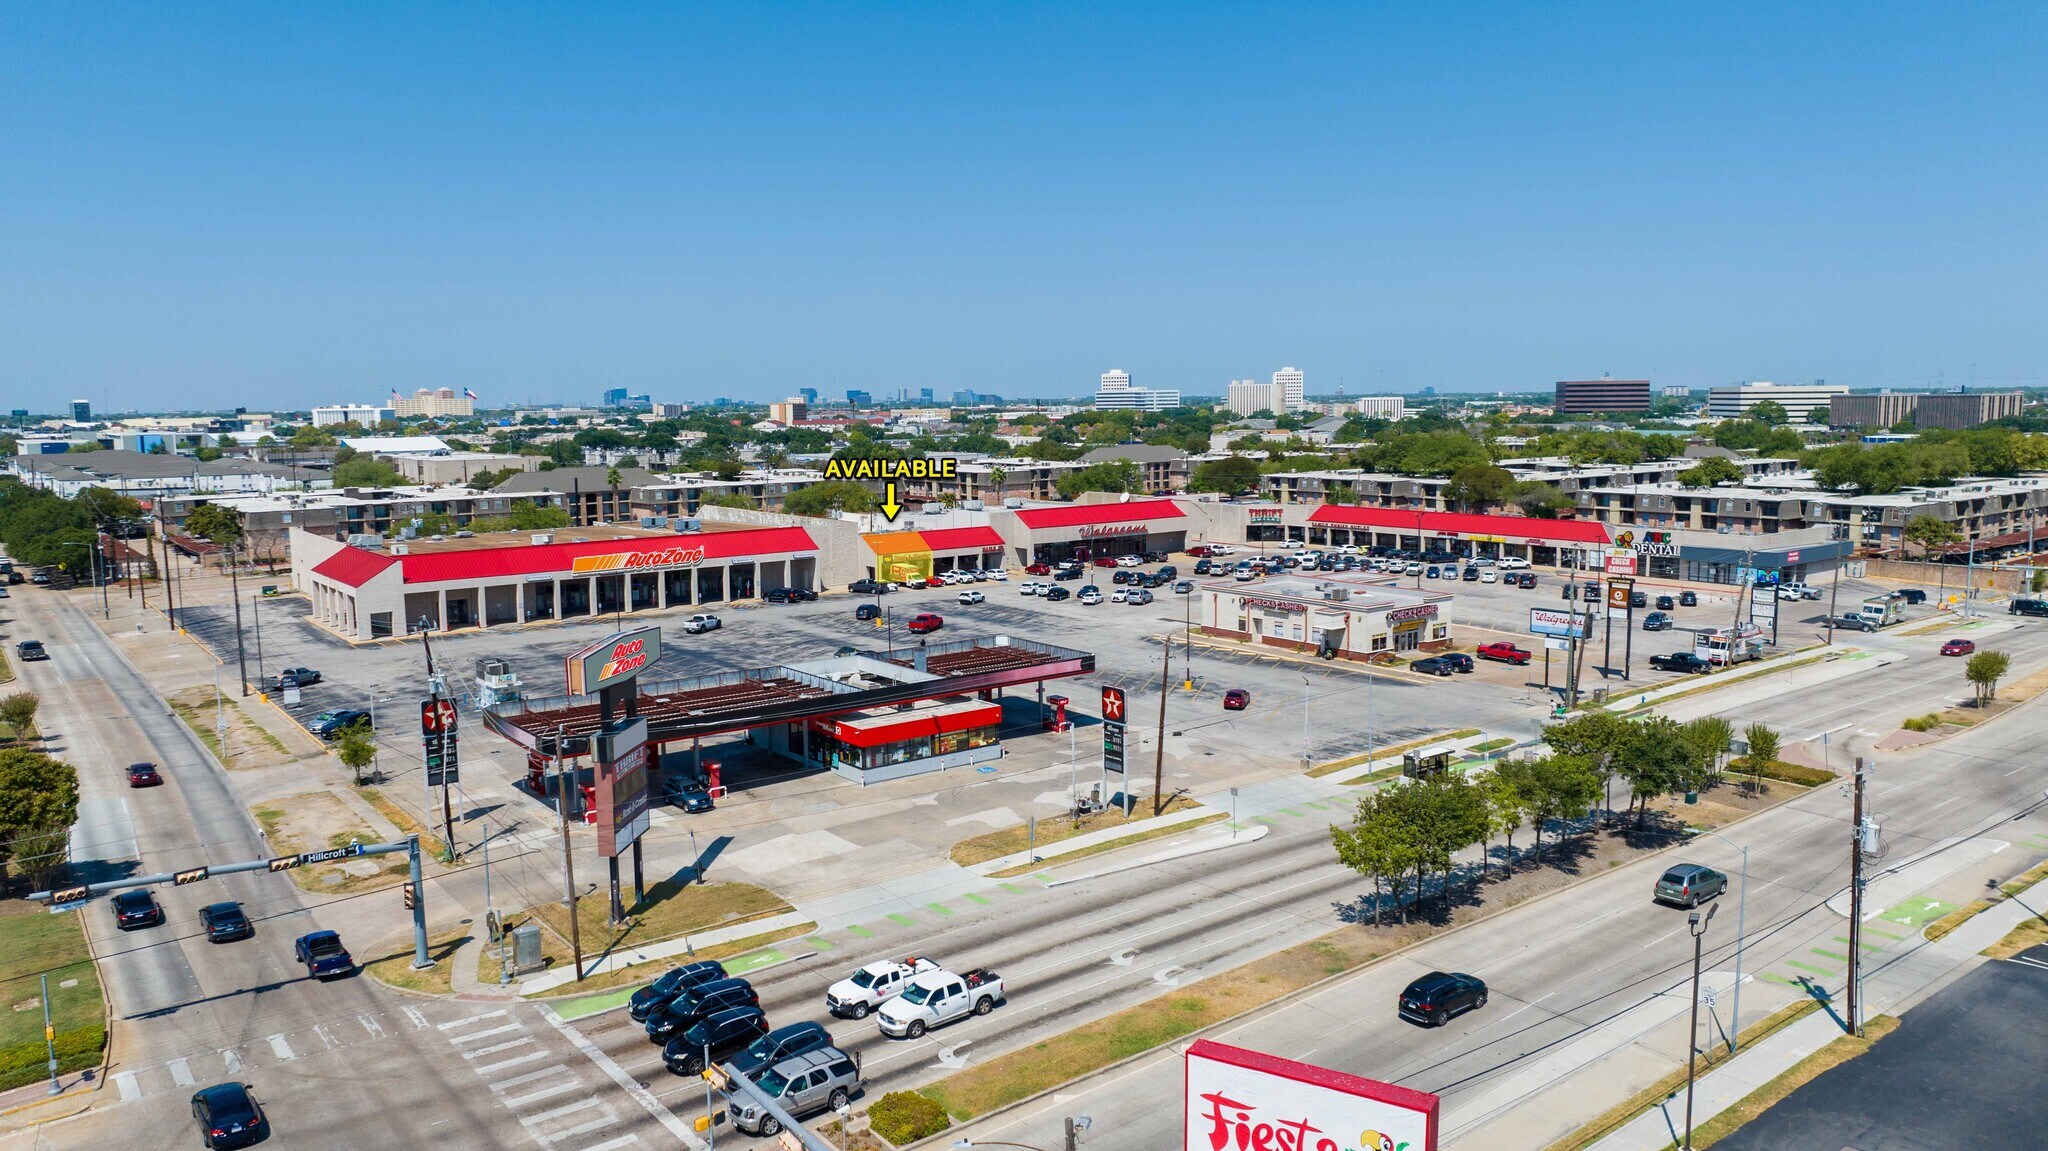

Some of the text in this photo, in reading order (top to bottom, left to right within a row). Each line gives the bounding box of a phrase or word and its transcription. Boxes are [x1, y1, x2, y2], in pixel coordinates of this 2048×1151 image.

[1249, 508, 1283, 518] THRIFT
[1079, 524, 1148, 538] Walgreens
[1642, 531, 1672, 544] ABC
[624, 548, 702, 568] AutoZone
[1611, 557, 1631, 566] CHECK
[1608, 565, 1634, 574] CASHING
[1250, 599, 1276, 608] CHECKS
[1276, 602, 1304, 612] CASHED
[1393, 605, 1439, 620] CHECKS CASHED
[611, 639, 643, 661] Auto
[612, 653, 646, 677] Zone
[614, 746, 645, 772] THRIFT
[308, 848, 346, 863] Hillcroft
[1703, 996, 1715, 1006] 35
